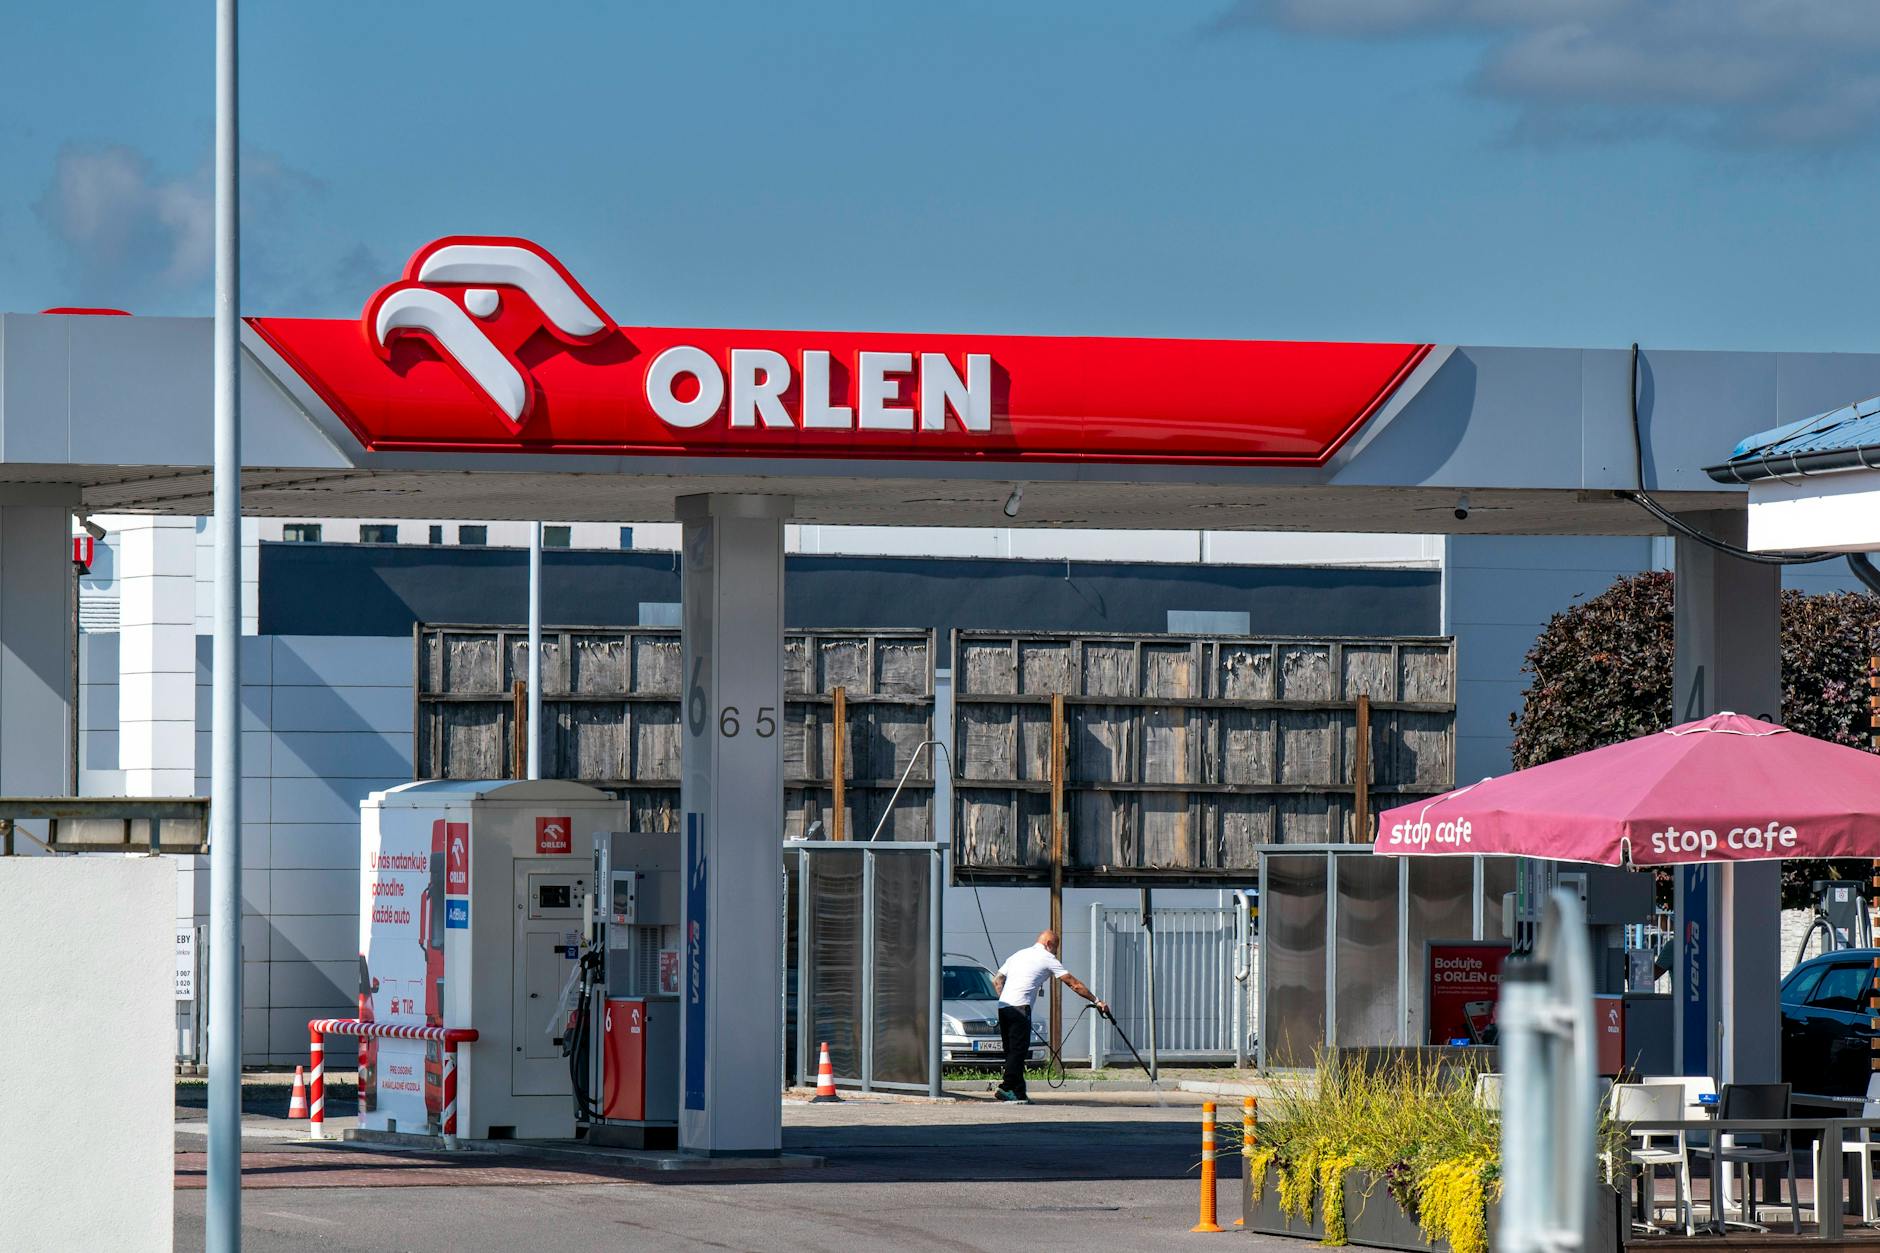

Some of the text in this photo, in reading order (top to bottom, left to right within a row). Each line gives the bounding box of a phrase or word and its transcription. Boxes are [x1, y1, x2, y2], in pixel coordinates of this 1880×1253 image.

[646, 345, 992, 431] ORLEN
[688, 656, 707, 738] 6
[1683, 665, 1705, 721] 4
[720, 706, 776, 738] 6 5
[1389, 816, 1472, 851] stop cafe
[1651, 821, 1798, 859] stop cafe
[540, 841, 567, 849] ORLEN
[371, 851, 427, 873] U nás natankuje
[372, 879, 405, 898] pohodlne
[449, 871, 466, 884] ORLEN
[372, 905, 411, 925] každé auto
[448, 907, 467, 921] AdBlue
[689, 920, 701, 1004] verva
[1434, 957, 1483, 971] Bodujte
[1688, 921, 1701, 1002] verva
[1434, 973, 1441, 983] s
[1443, 971, 1487, 983] ORLEN
[402, 999, 414, 1015] TIR
[605, 1007, 612, 1032] 6
[1607, 1025, 1620, 1034] ORLEN
